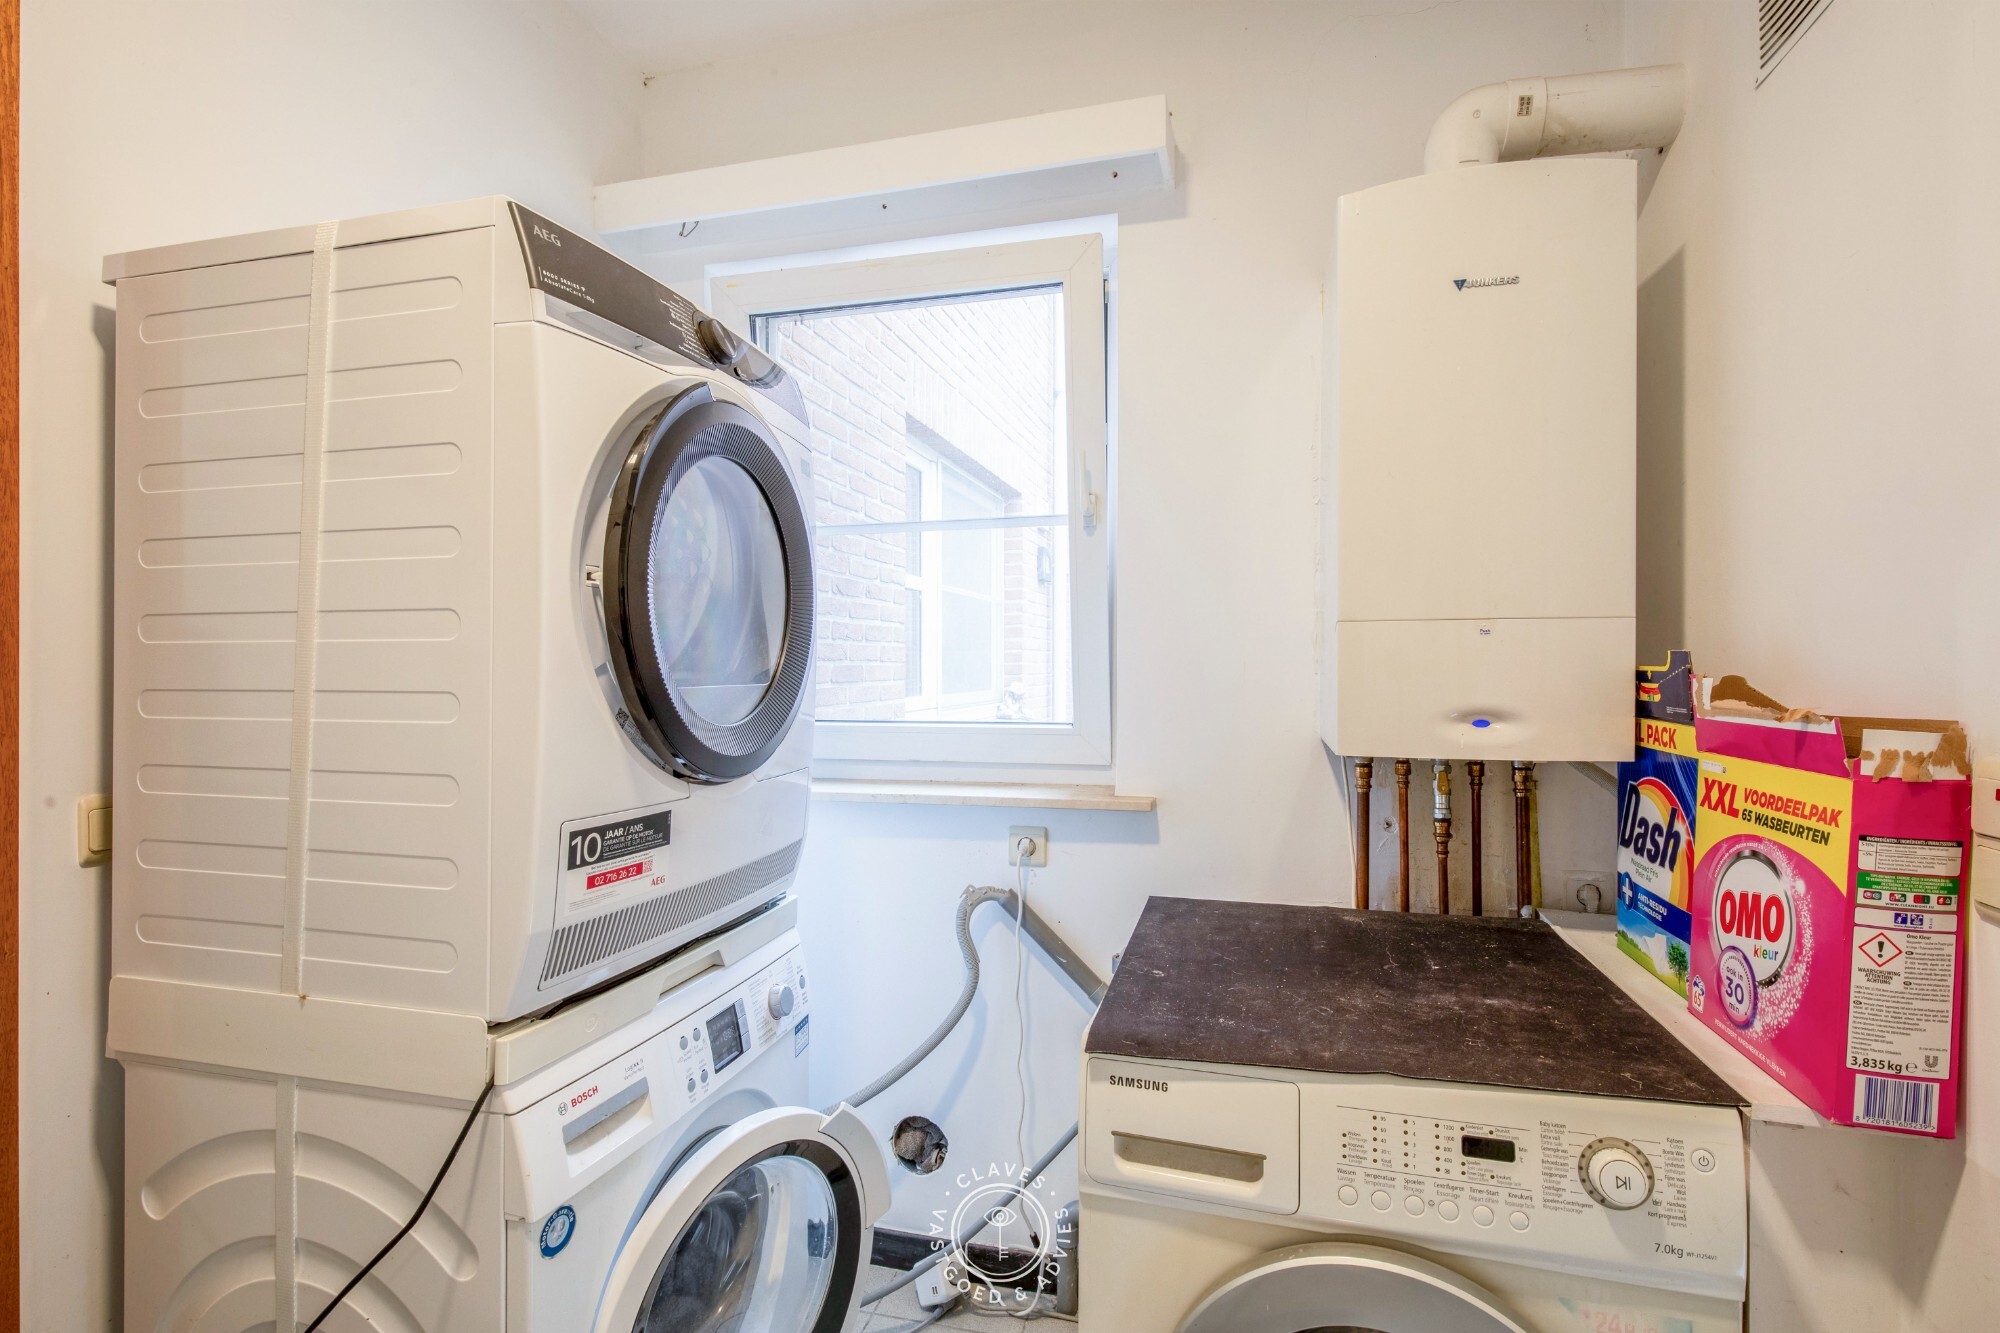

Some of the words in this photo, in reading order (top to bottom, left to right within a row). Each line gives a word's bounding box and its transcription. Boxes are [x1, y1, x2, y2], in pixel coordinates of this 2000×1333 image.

[534, 225, 562, 248] AEG
[1466, 276, 1520, 289] JUNKERS
[1647, 723, 1677, 750] PACK
[1700, 776, 1740, 819] XXL
[1744, 787, 1843, 828] VOORDEELPAK
[1620, 780, 1682, 873] Dash
[1742, 808, 1752, 823] 65
[1754, 811, 1831, 846] WASBEURTEN
[571, 832, 602, 867] 10
[605, 828, 623, 840] JAAR
[629, 823, 644, 834] ANS
[603, 837, 625, 847] GARANTIE
[594, 875, 605, 886] 02
[606, 872, 617, 883] 716
[619, 869, 627, 879] 26
[628, 866, 637, 876] 22
[650, 875, 666, 887] AEG
[1638, 892, 1667, 916] ANTI-RESIDU
[1719, 888, 1785, 944] OMO
[1753, 944, 1779, 962] kleur
[1726, 965, 1737, 978] ook
[1737, 969, 1744, 983] in
[1857, 966, 1901, 977] WAARSCHUWING
[1864, 972, 1893, 981] ATTENTION
[1866, 977, 1891, 986] ACHTUNG
[1725, 976, 1745, 1006] 30
[1693, 990, 1702, 1008] 65
[1728, 1001, 1740, 1015] min
[1851, 1055, 1885, 1071] 3,835
[1888, 1059, 1902, 1075] kg
[1109, 1075, 1169, 1093] SAMSUNG
[570, 1085, 599, 1108] BOSCH
[1866, 1116, 1895, 1127] 720181
[1898, 1120, 1928, 1132] 605239
[1666, 1137, 1684, 1145] Katoen
[1669, 1143, 1684, 1151] Coton
[1541, 1158, 1569, 1167] Behoedzaam
[1337, 1167, 1357, 1176] Wassen
[1363, 1172, 1396, 1182] Temperatuur
[1337, 1175, 1355, 1183] Lavage
[1403, 1178, 1425, 1186] Spoelen
[1664, 1175, 1675, 1183] Fijne
[1403, 1185, 1425, 1194] Rinçage
[1433, 1182, 1465, 1192] Centrifugeren
[1469, 1186, 1500, 1197] Timer-Start
[1436, 1190, 1461, 1200] Essorage
[1508, 1192, 1533, 1203] Kreukvrij
[1667, 1201, 1687, 1209] Handwas
[1648, 1211, 1658, 1219] Kort
[1667, 1220, 1687, 1229] Express
[1654, 1243, 1684, 1260] 7.0kg
